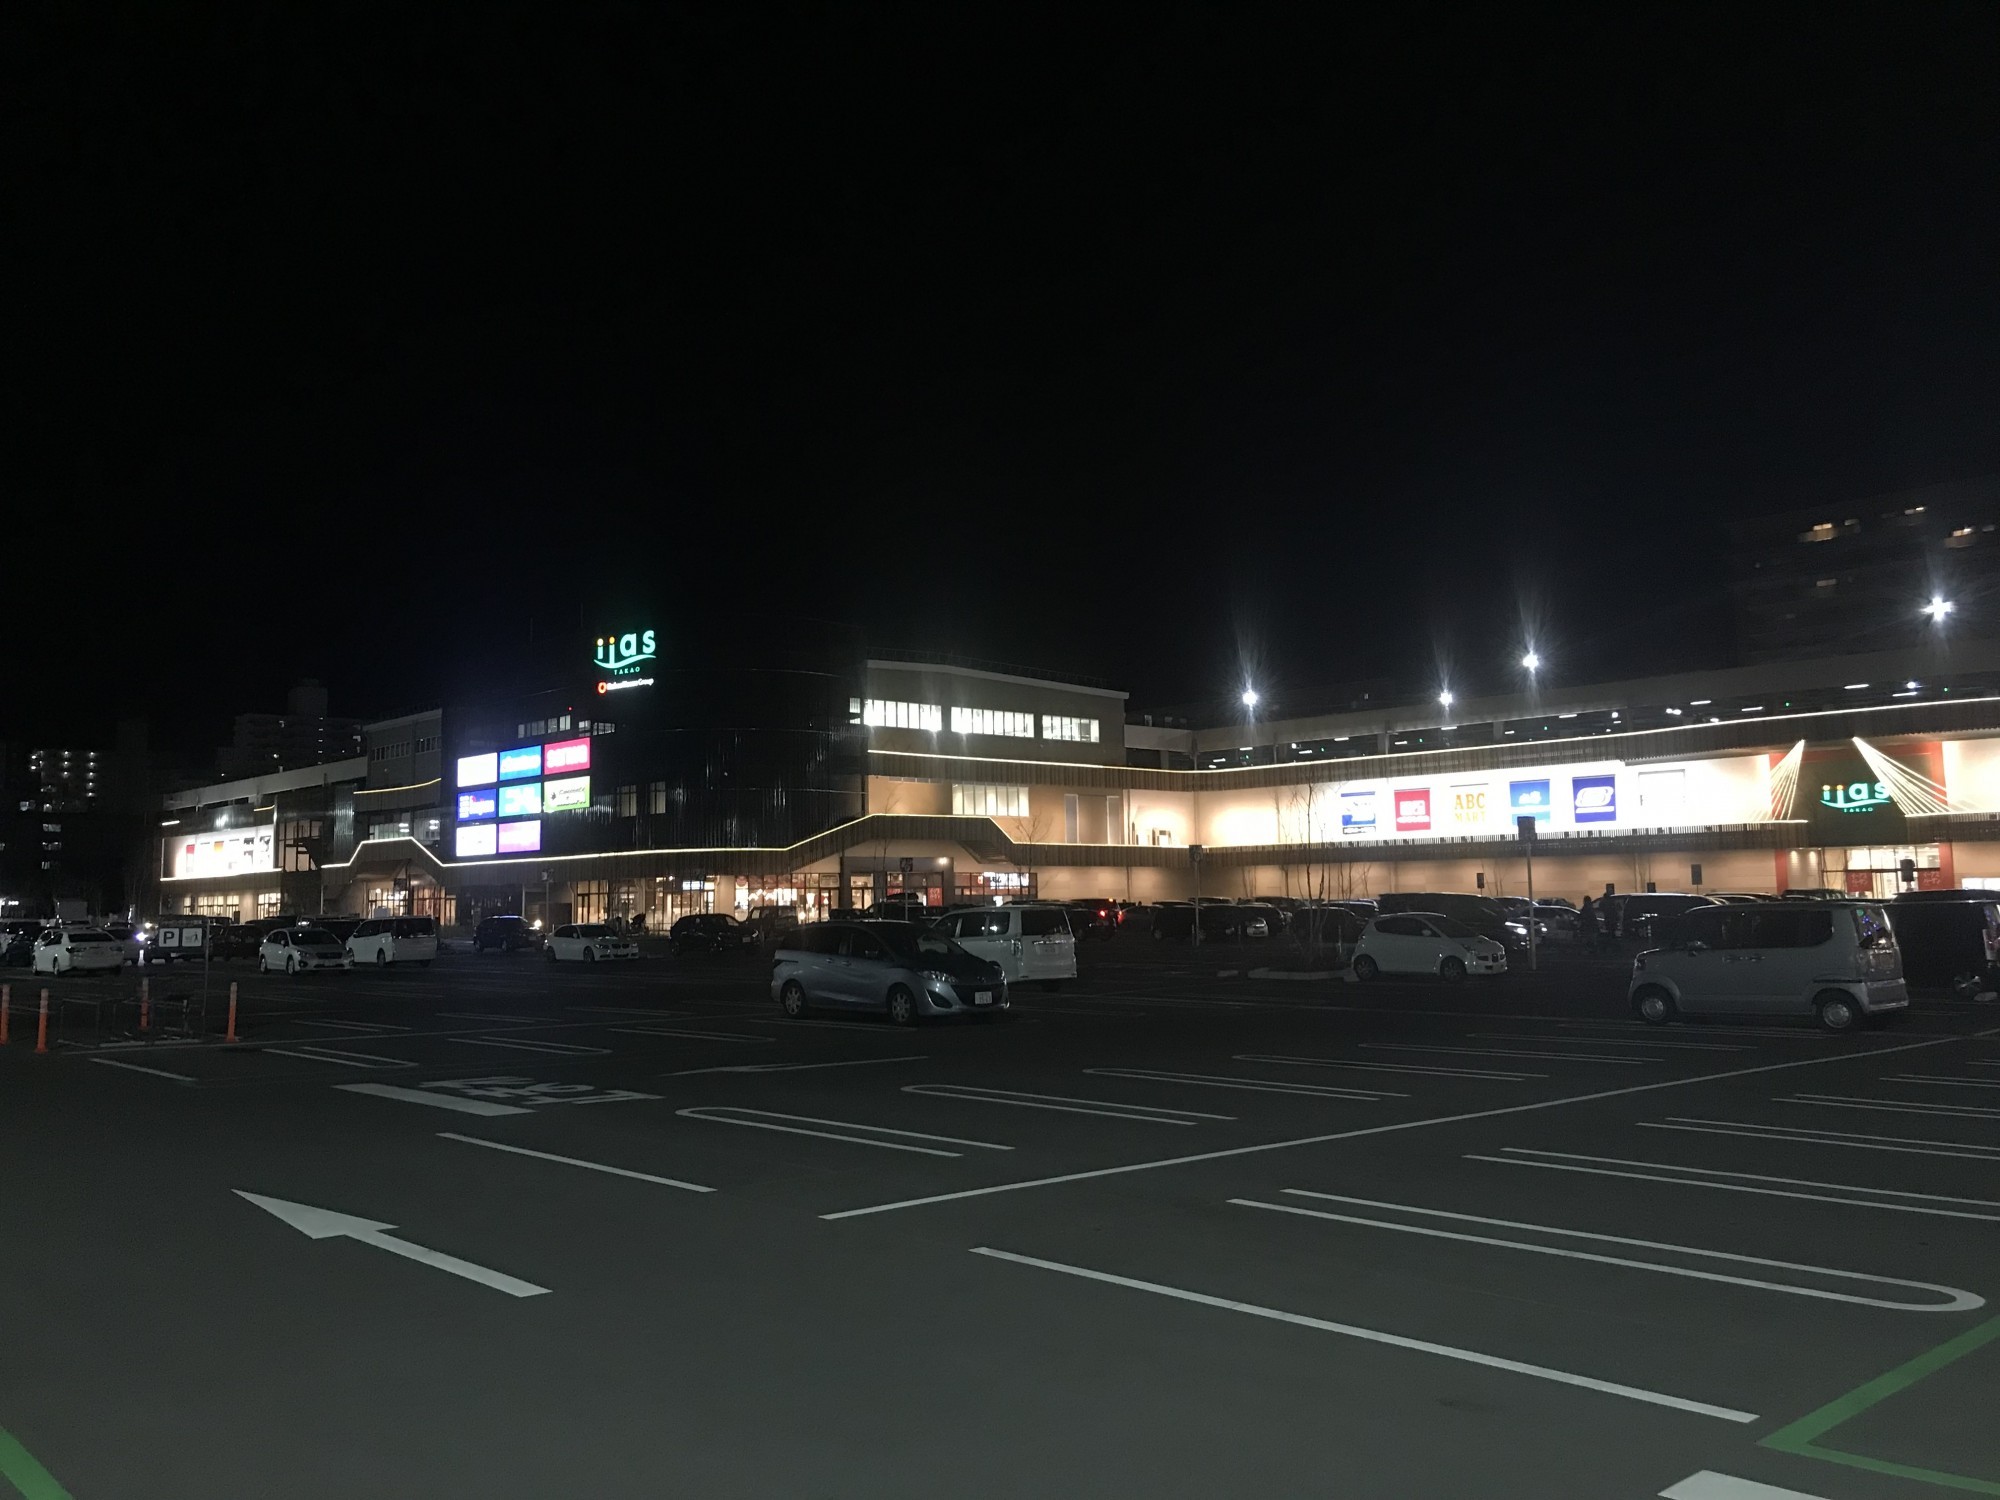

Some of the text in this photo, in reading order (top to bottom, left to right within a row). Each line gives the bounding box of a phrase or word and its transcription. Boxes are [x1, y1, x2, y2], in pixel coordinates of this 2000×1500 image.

[614, 666, 641, 675] TAKAO
[1455, 789, 1486, 810] ABC
[163, 931, 175, 944] P
